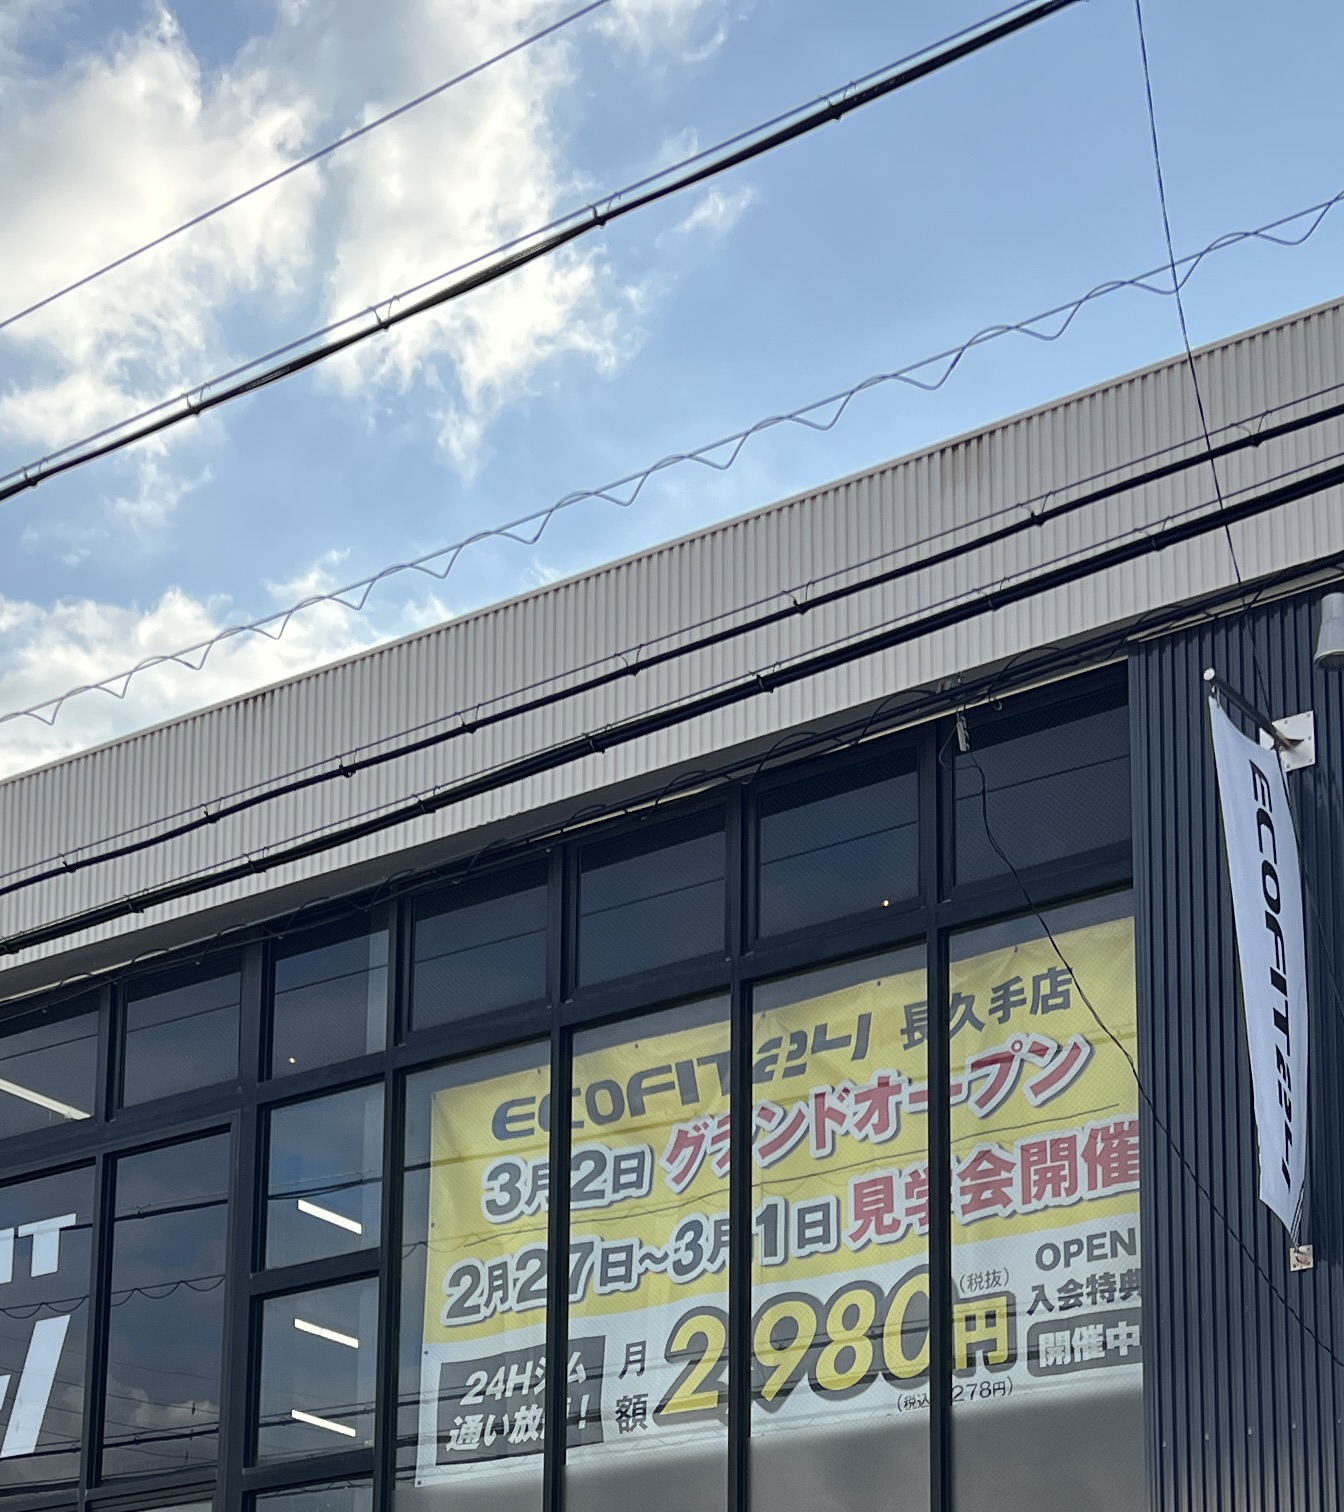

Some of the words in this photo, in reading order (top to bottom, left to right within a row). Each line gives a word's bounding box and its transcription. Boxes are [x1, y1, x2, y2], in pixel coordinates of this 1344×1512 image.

[1248, 758, 1293, 1192] ECOFIT24
[1035, 1228, 1137, 1271] OPEN
[959, 1267, 1010, 1294] (税抜)
[1026, 1268, 1142, 1316] 入会特典
[656, 1270, 1012, 1417] 2980円
[1037, 1320, 1142, 1369] 開催中
[445, 1393, 590, 1452] 通い放！
